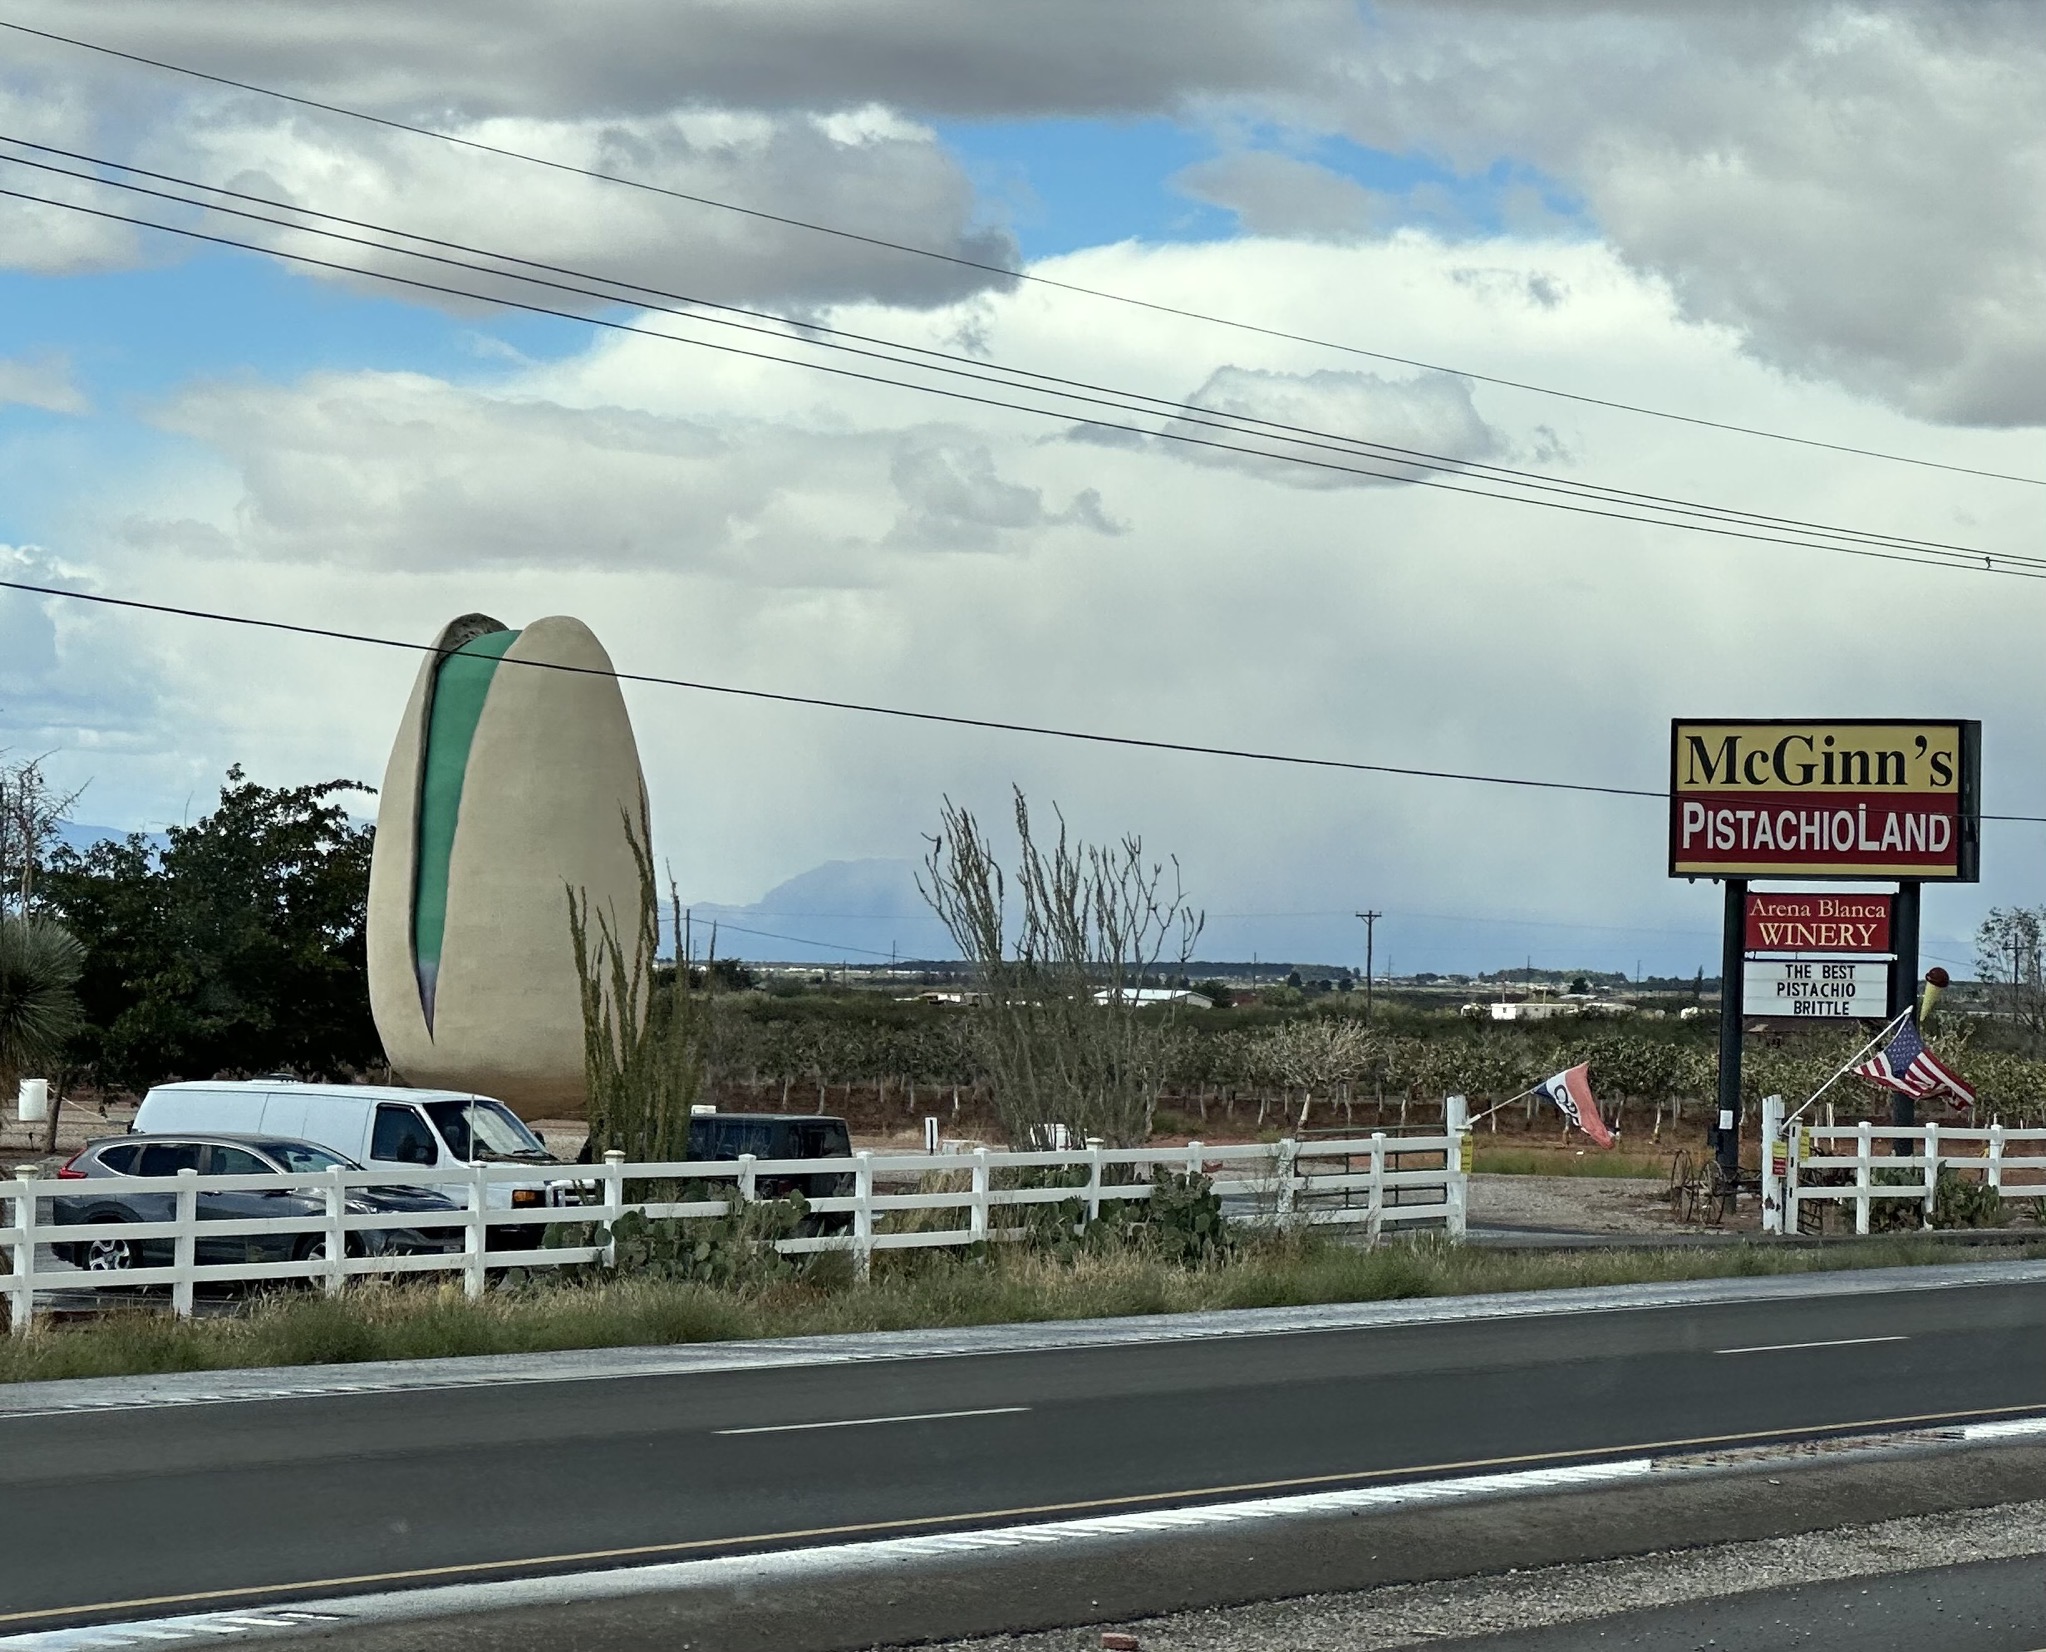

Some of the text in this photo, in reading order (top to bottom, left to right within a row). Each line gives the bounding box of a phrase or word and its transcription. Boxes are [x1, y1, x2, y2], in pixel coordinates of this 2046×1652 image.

[1684, 735, 1953, 787] McGinn's
[1682, 802, 1951, 852] PISTACHIOLAND
[1749, 898, 1886, 918] Arena Blanca
[1759, 923, 1877, 947] WINERY
[1785, 964, 1855, 980] THE BEST
[1777, 982, 1856, 998] PISTACHIO
[1793, 1001, 1849, 1016] BRITTLE
